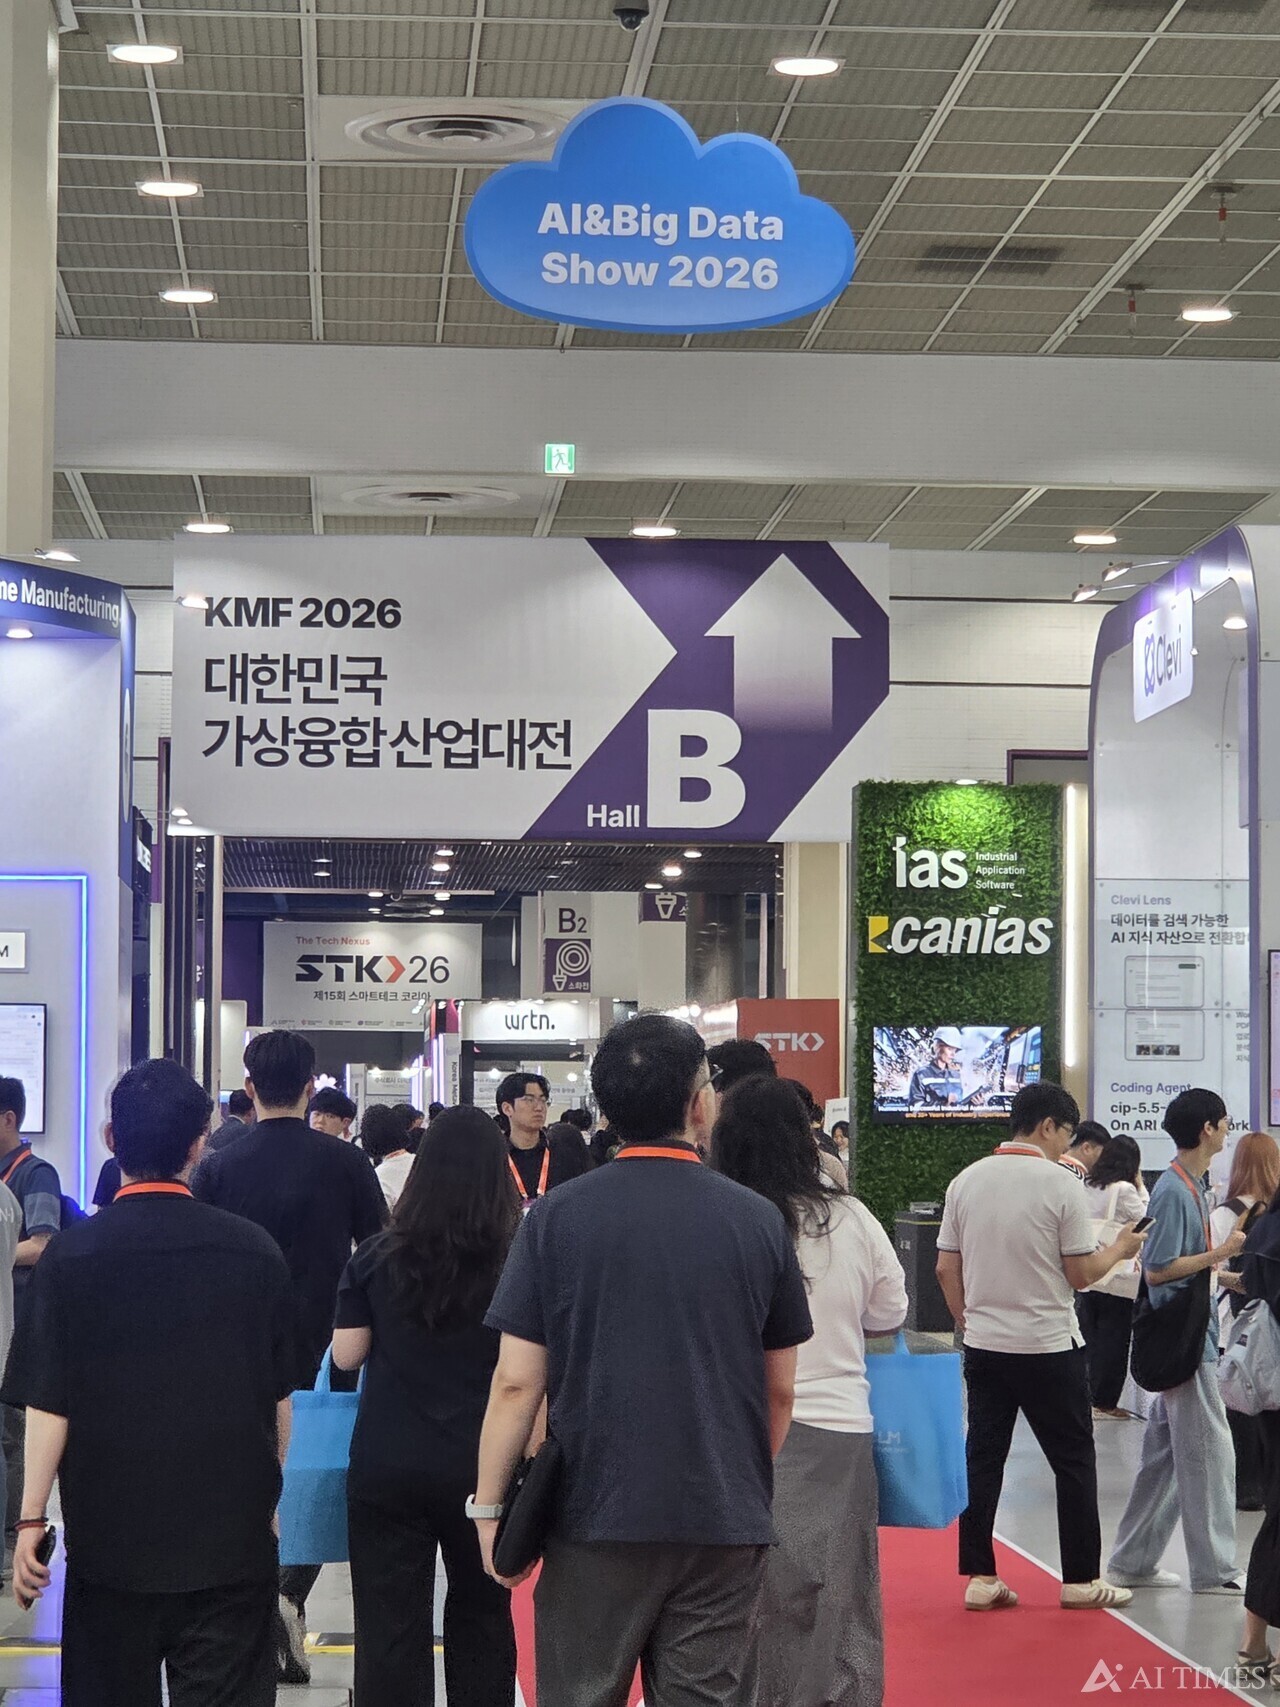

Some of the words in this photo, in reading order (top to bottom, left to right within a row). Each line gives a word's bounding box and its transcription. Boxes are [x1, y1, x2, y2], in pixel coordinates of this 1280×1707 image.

[537, 202, 678, 247] AI&Big
[689, 206, 783, 241] Data
[541, 252, 659, 286] Show
[668, 255, 779, 290] 2026
[204, 597, 293, 628] KMF
[300, 597, 402, 629] 2026
[1156, 623, 1182, 687] Clevi
[204, 652, 388, 707] 대한민국
[586, 803, 640, 829] Hall
[646, 708, 746, 829] B
[892, 836, 969, 889] ias
[975, 851, 1018, 862] Industrial
[975, 865, 1026, 876] Application
[975, 880, 1015, 890] Software
[1110, 894, 1141, 906] Clevi
[1143, 895, 1172, 906] Lens
[558, 907, 588, 934] B2
[890, 906, 1054, 956] canias
[1110, 913, 1160, 928] 데이터를
[1163, 913, 1188, 928] 검색
[1191, 913, 1229, 928] 가능한
[295, 936, 313, 946] The
[316, 936, 339, 946] Tech
[341, 936, 371, 947] Nexus
[1110, 932, 1125, 943] AI
[1128, 930, 1152, 945] 지식
[1156, 931, 1206, 945] 자산으로
[1209, 931, 1250, 945] 전환합
[295, 954, 384, 983] STK
[408, 955, 450, 984] 26
[313, 990, 346, 1002] 제15회
[349, 991, 400, 1002] 스마트테크
[401, 991, 431, 1003] 코리아
[504, 1009, 556, 1030] wrtn.
[1110, 1082, 1153, 1095] Coding
[1155, 1082, 1192, 1095] Agent
[1110, 1119, 1130, 1131] On
[1133, 1119, 1157, 1131] ARI
